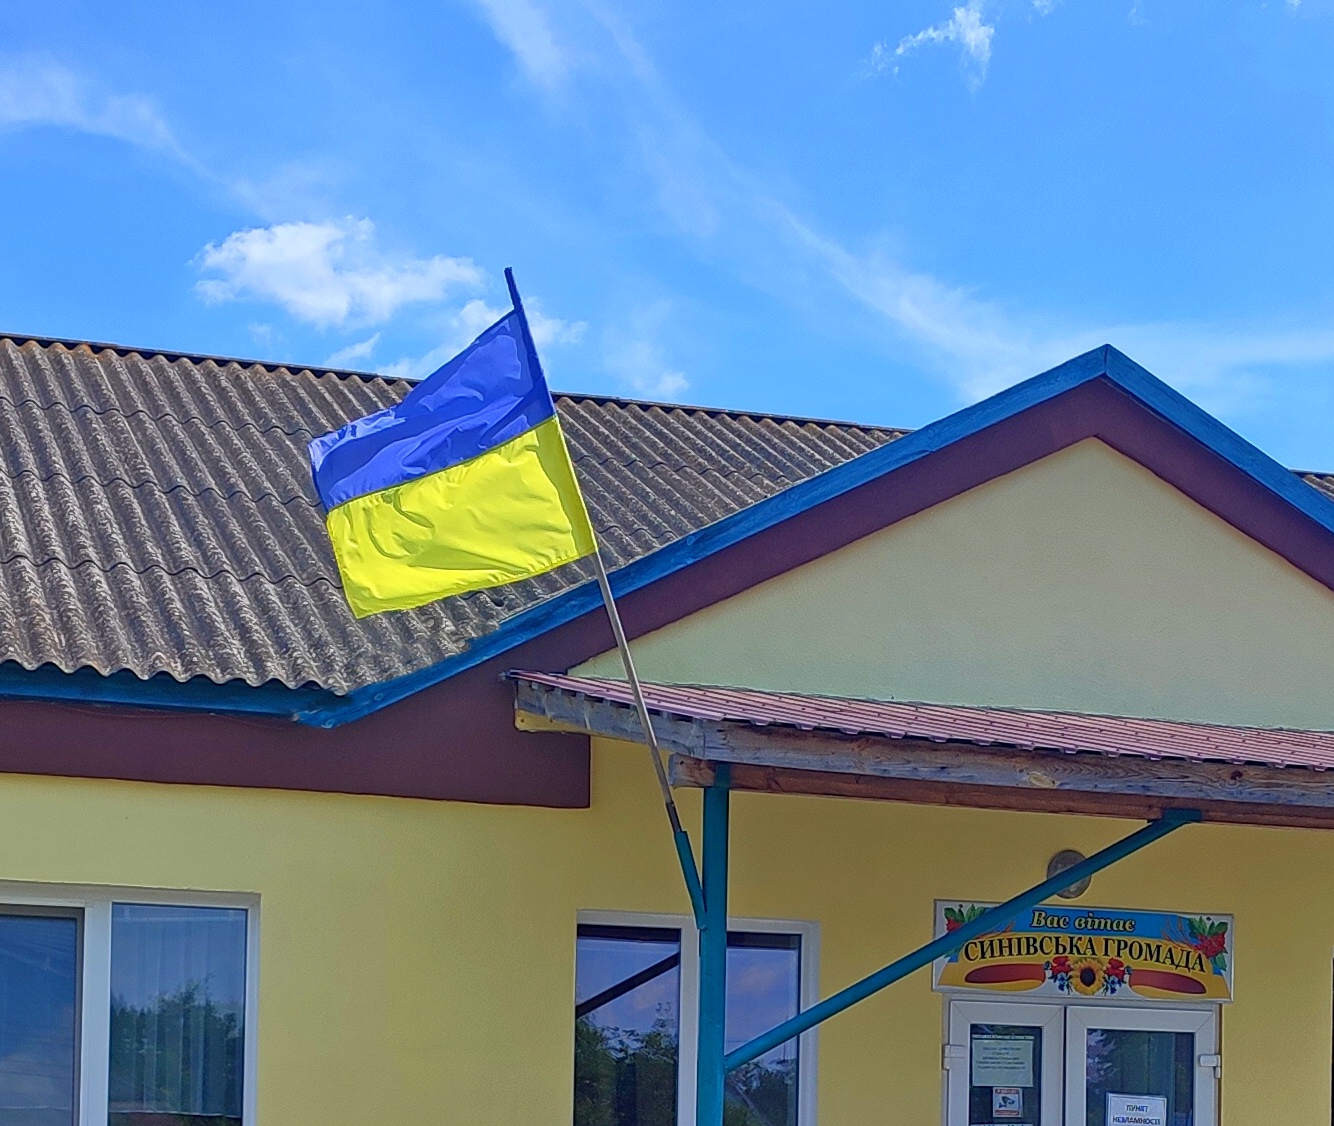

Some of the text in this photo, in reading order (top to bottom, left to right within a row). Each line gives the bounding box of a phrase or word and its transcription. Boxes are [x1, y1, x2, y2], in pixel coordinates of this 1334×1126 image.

[1031, 910, 1136, 933] Вас вітає
[964, 935, 1207, 974] СИНІВСЬКА ГРОМАДА
